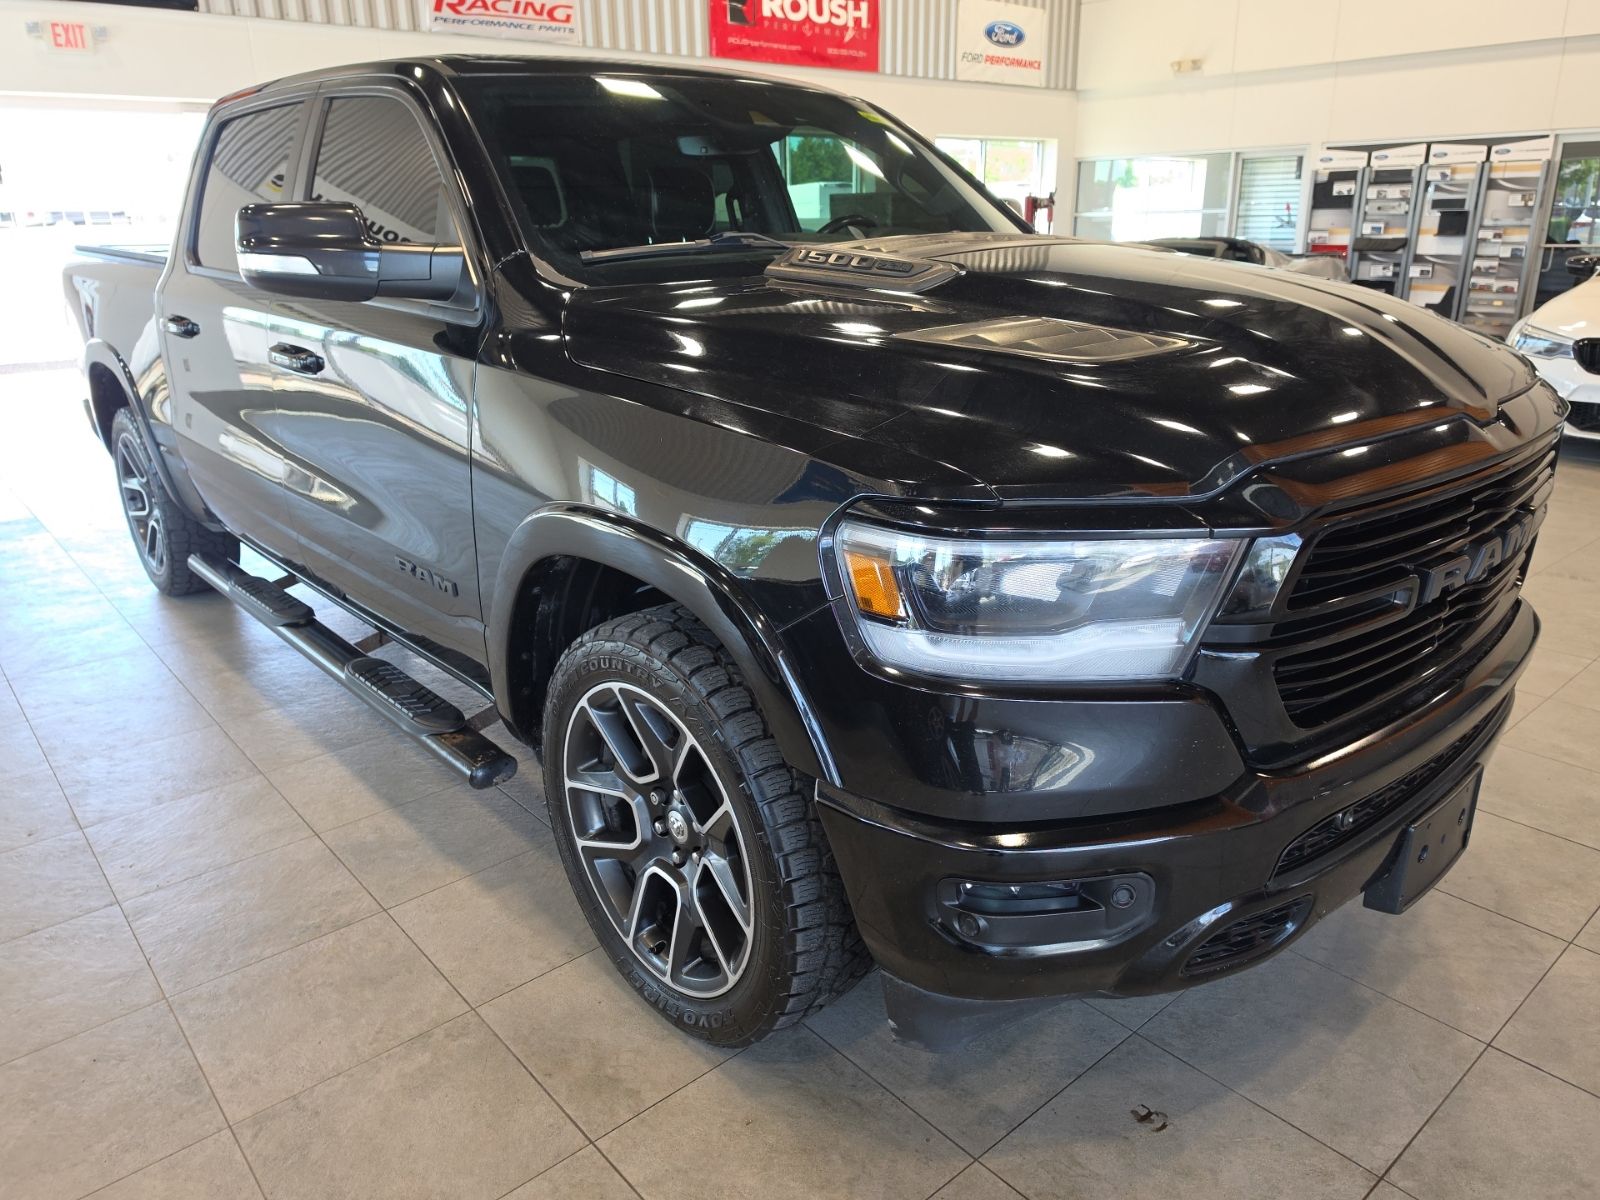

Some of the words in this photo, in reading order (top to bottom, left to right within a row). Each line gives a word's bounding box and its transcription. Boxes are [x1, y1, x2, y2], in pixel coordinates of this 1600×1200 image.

[433, 0, 574, 24] RACING
[761, 0, 870, 29] ROUSH
[50, 22, 87, 49] EXIT
[434, 16, 535, 31] PERFORMANCE
[538, 24, 575, 34] PARTS
[991, 24, 1020, 45] Ford
[961, 52, 983, 64] FORD
[984, 54, 1042, 71] PERFORMANCE
[799, 249, 876, 271] 1500
[1421, 512, 1534, 605] RAM
[394, 554, 459, 598] RAM
[580, 655, 664, 689] COUNTRY
